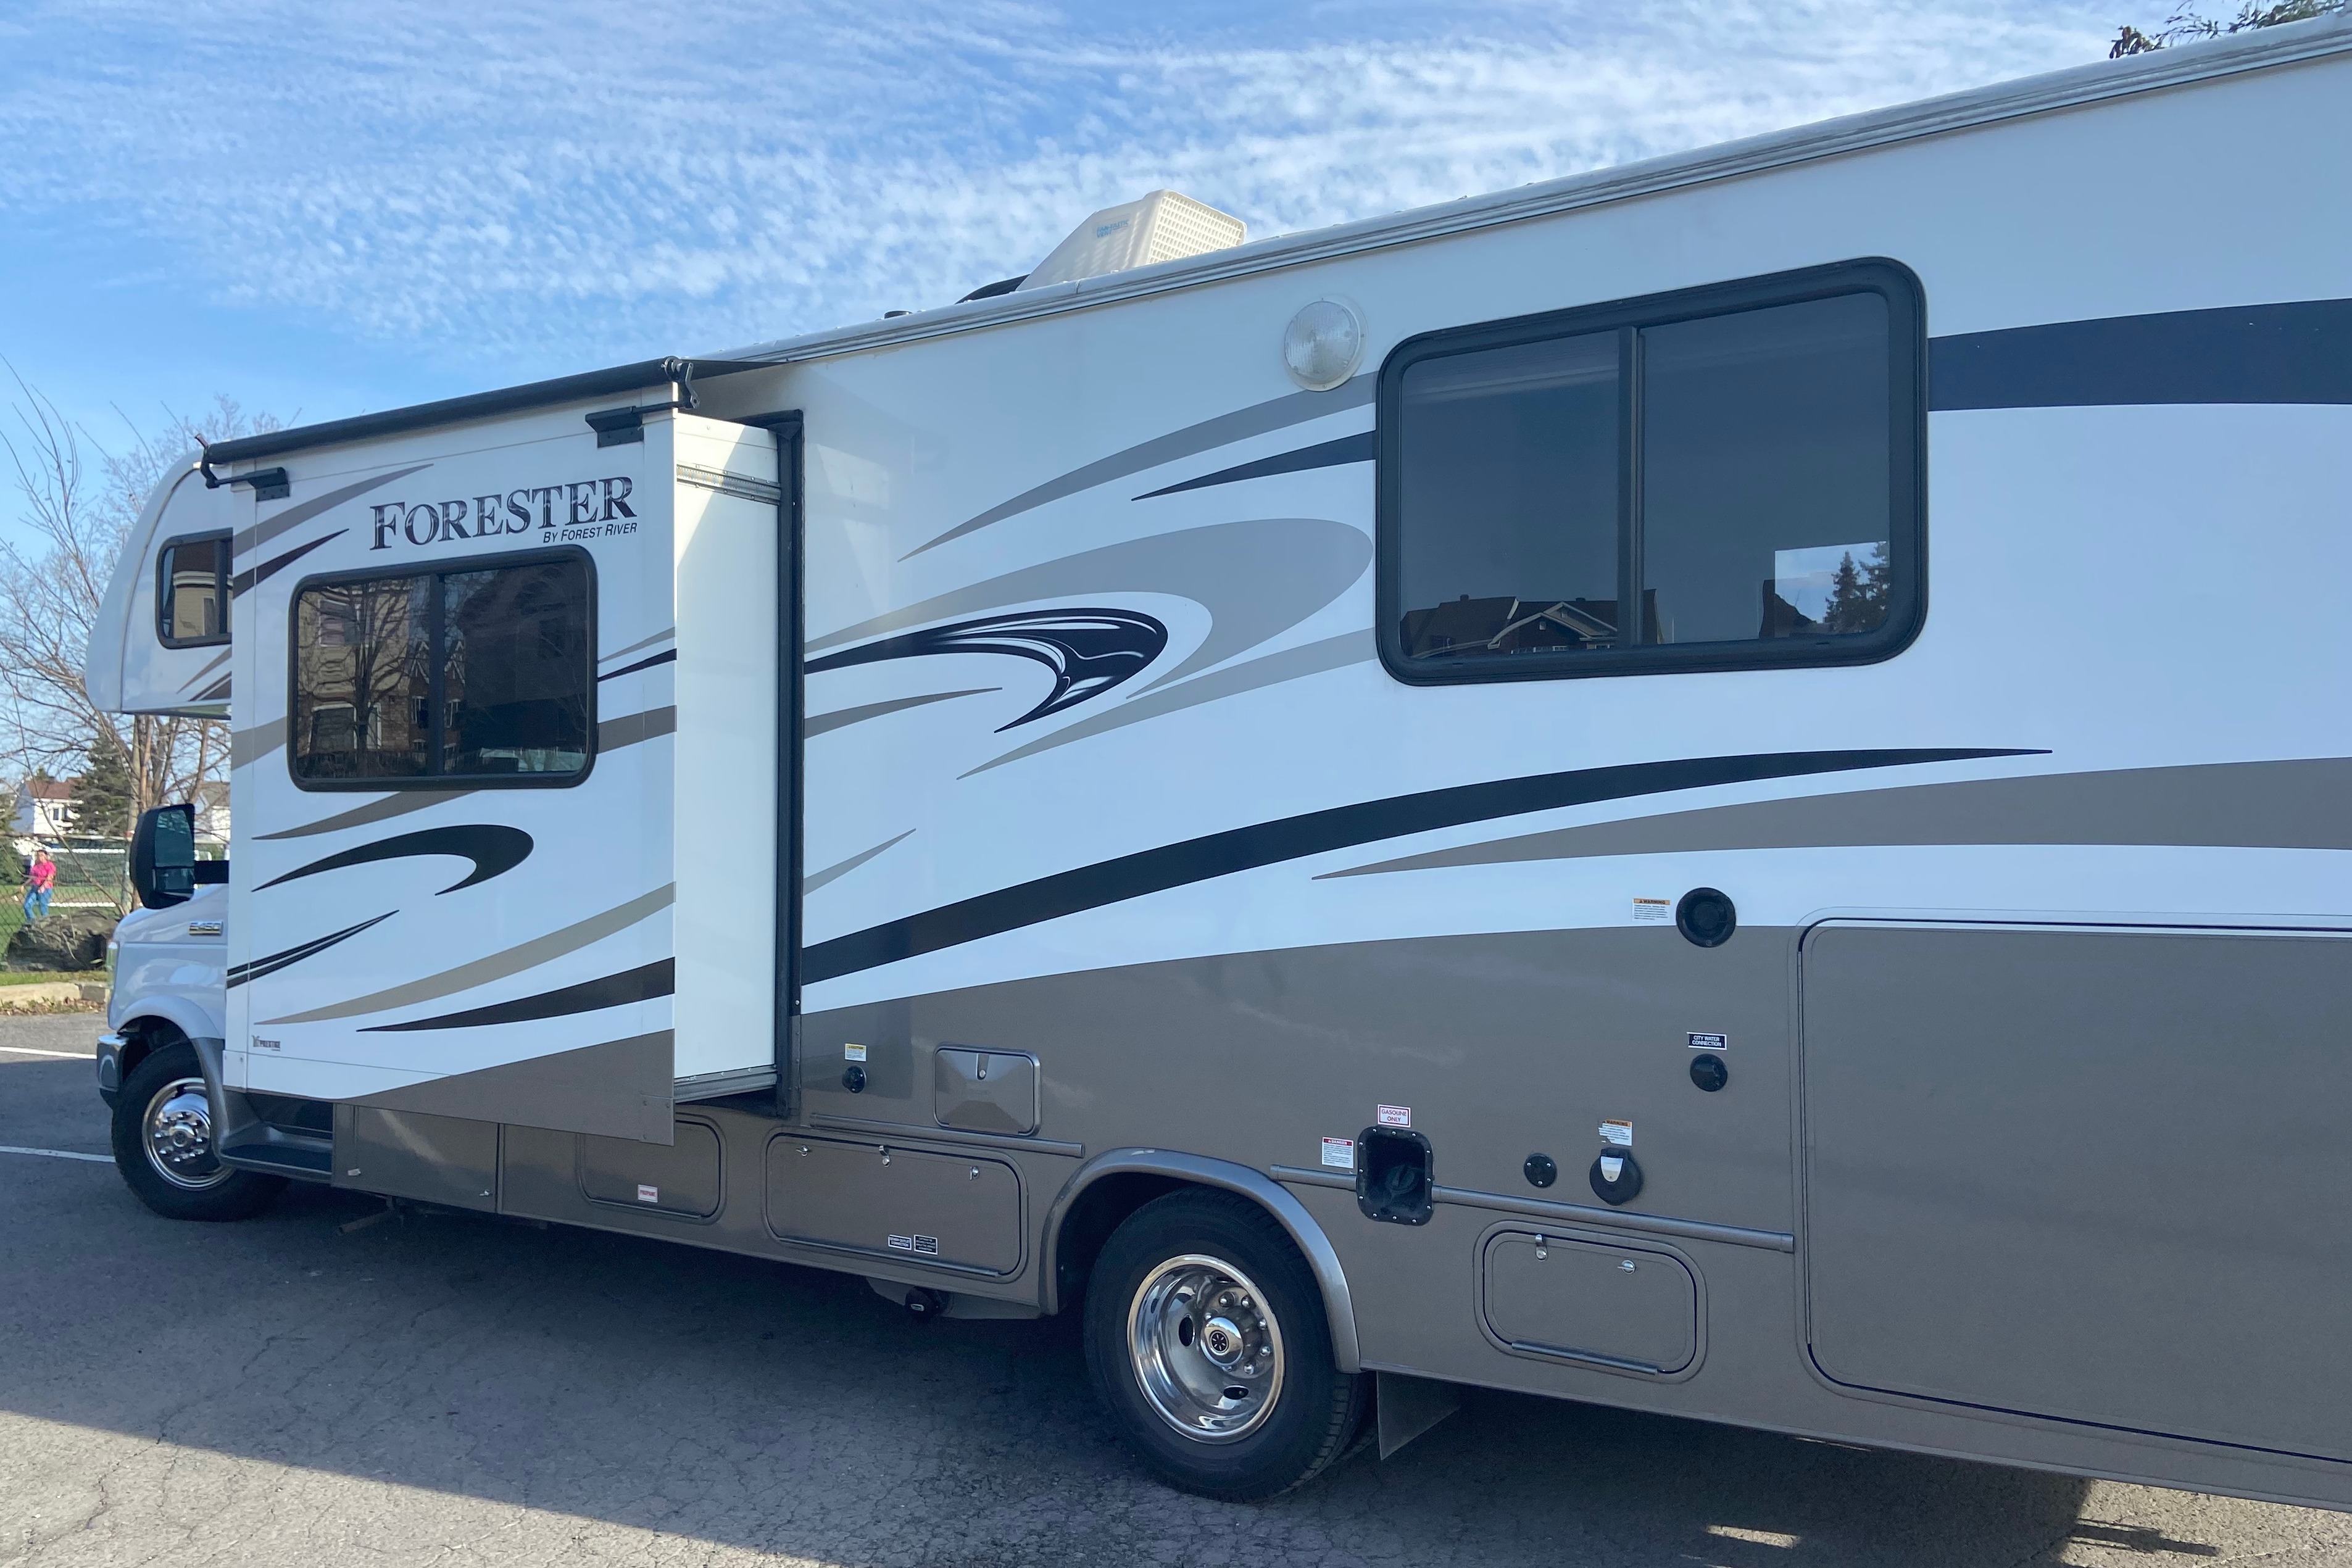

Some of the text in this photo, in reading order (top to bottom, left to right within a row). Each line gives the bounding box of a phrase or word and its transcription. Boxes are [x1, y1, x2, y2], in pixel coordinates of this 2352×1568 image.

[370, 476, 638, 550] FORESTER
[543, 523, 638, 543] BY FOREST RIVER
[1381, 1108, 1407, 1117] GASOLINE
